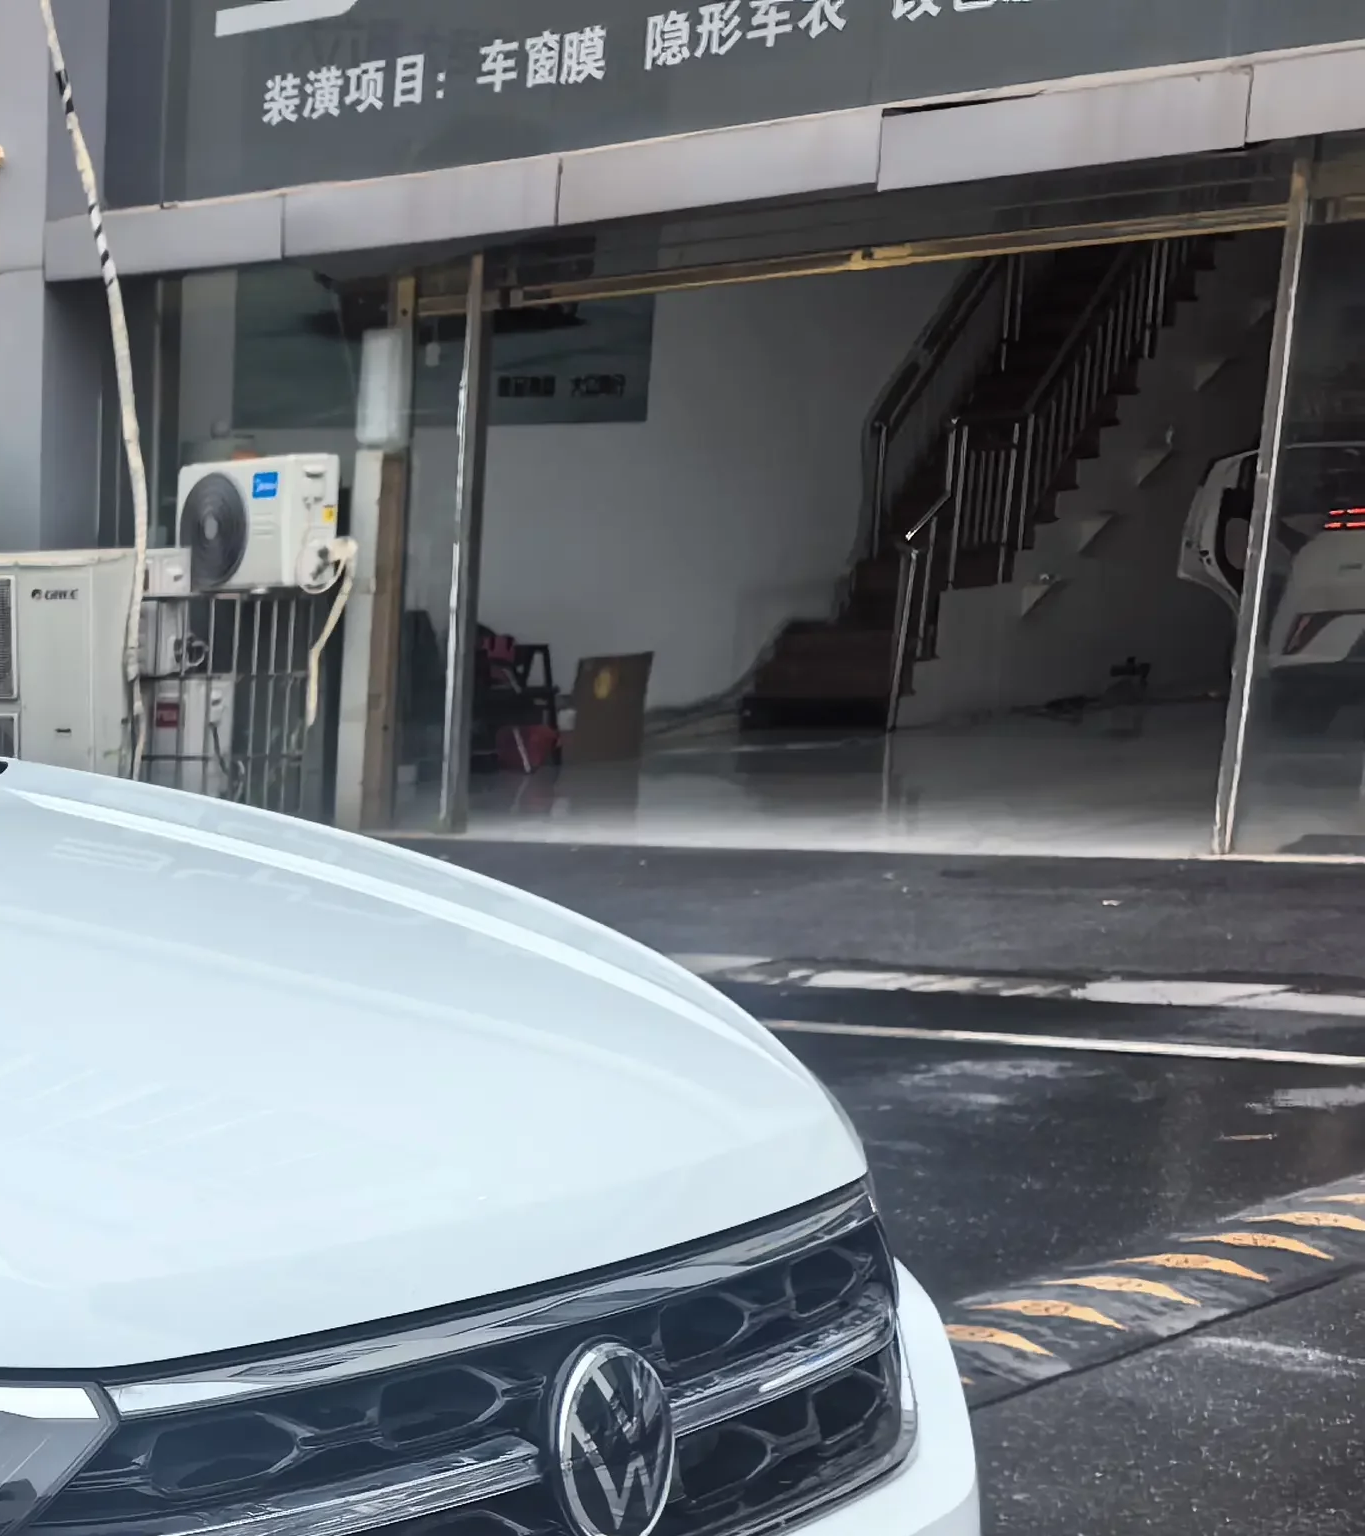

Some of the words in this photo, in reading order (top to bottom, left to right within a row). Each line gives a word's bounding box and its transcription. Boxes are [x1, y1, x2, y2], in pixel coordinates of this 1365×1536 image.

[476, 25, 607, 93] 车窗膜
[644, 0, 848, 70] 隐形车衣
